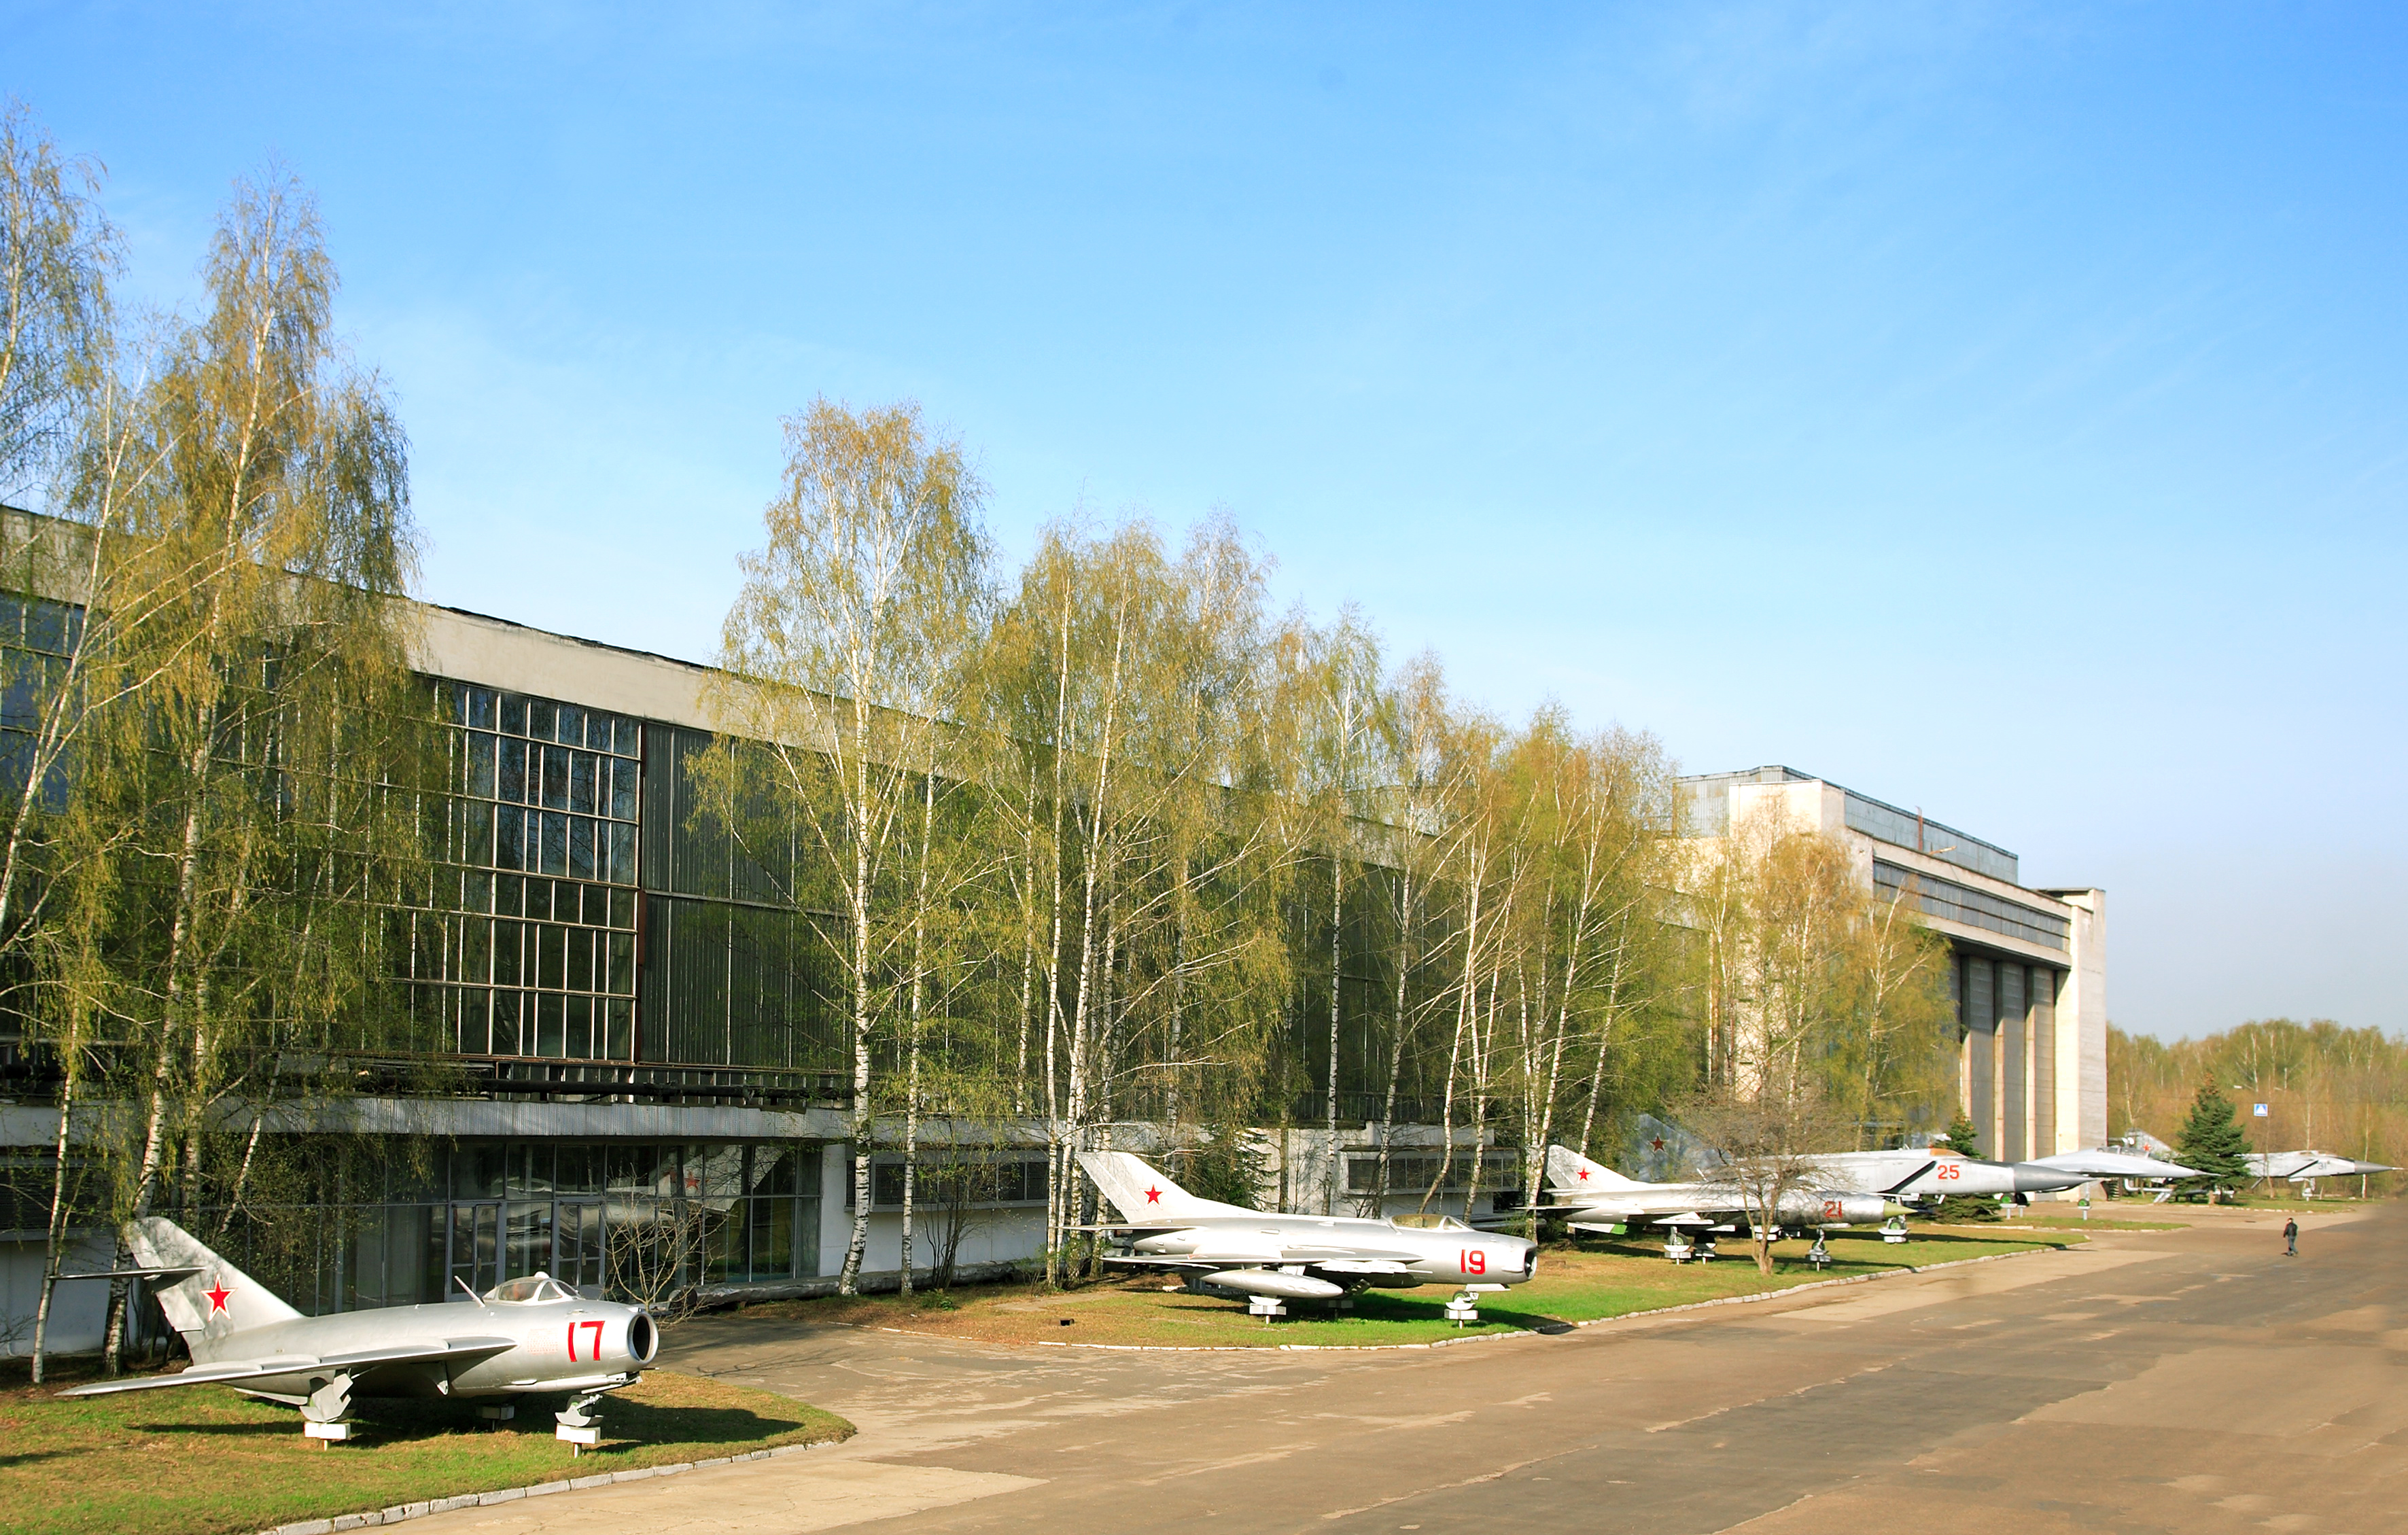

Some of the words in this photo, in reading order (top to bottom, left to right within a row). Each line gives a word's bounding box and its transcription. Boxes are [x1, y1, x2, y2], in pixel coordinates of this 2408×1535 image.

[1938, 1165, 1959, 1180] 25
[1824, 1201, 1843, 1218] 21
[1461, 1249, 1486, 1275] 19
[568, 1320, 605, 1362] 17
